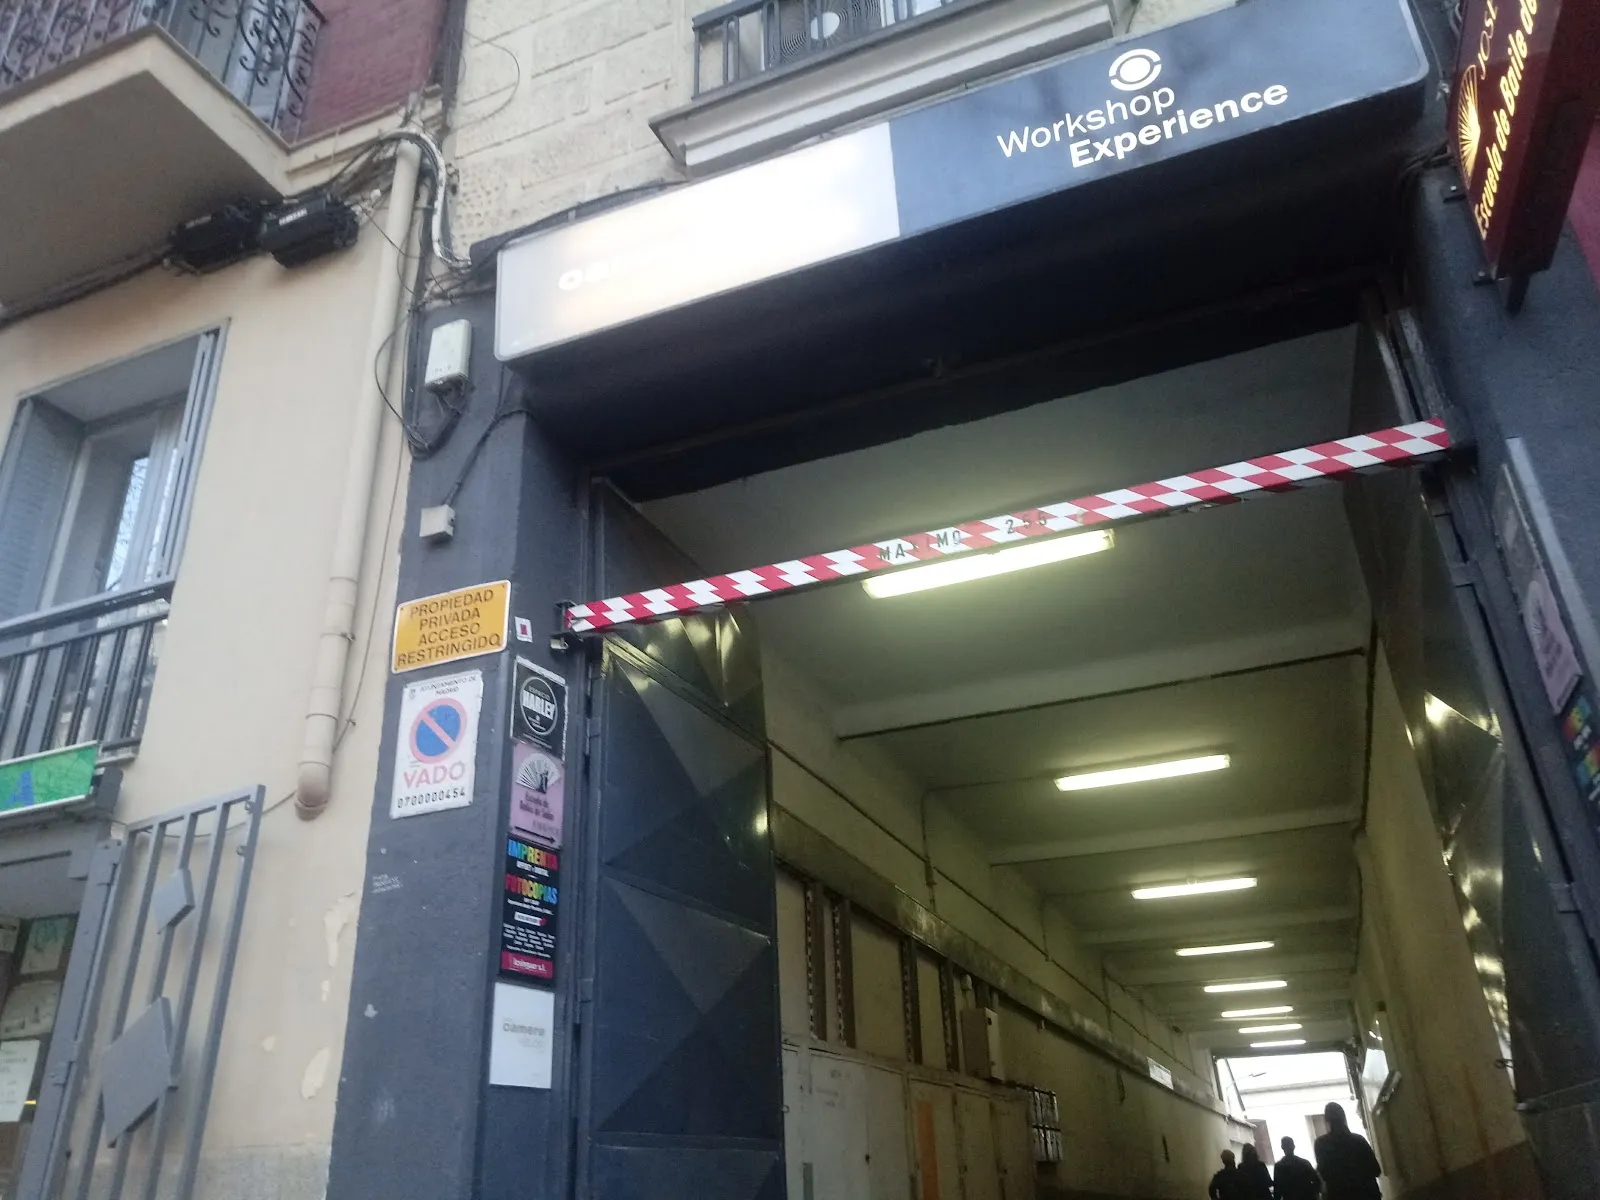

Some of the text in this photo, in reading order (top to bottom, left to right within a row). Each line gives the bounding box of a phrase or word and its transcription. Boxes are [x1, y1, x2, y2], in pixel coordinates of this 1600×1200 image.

[1500, 29, 1528, 117] Baile
[996, 86, 1175, 158] Workshop
[1069, 84, 1289, 168] Experience
[1493, 109, 1511, 151] de
[410, 589, 494, 619] PROPIEDAD
[420, 607, 480, 631] PRIVADA
[397, 633, 501, 667] RESTRINGIDO
[418, 622, 481, 646] ACCESO
[403, 760, 466, 789] VADO
[505, 873, 558, 905] FOTOCOPIAS
